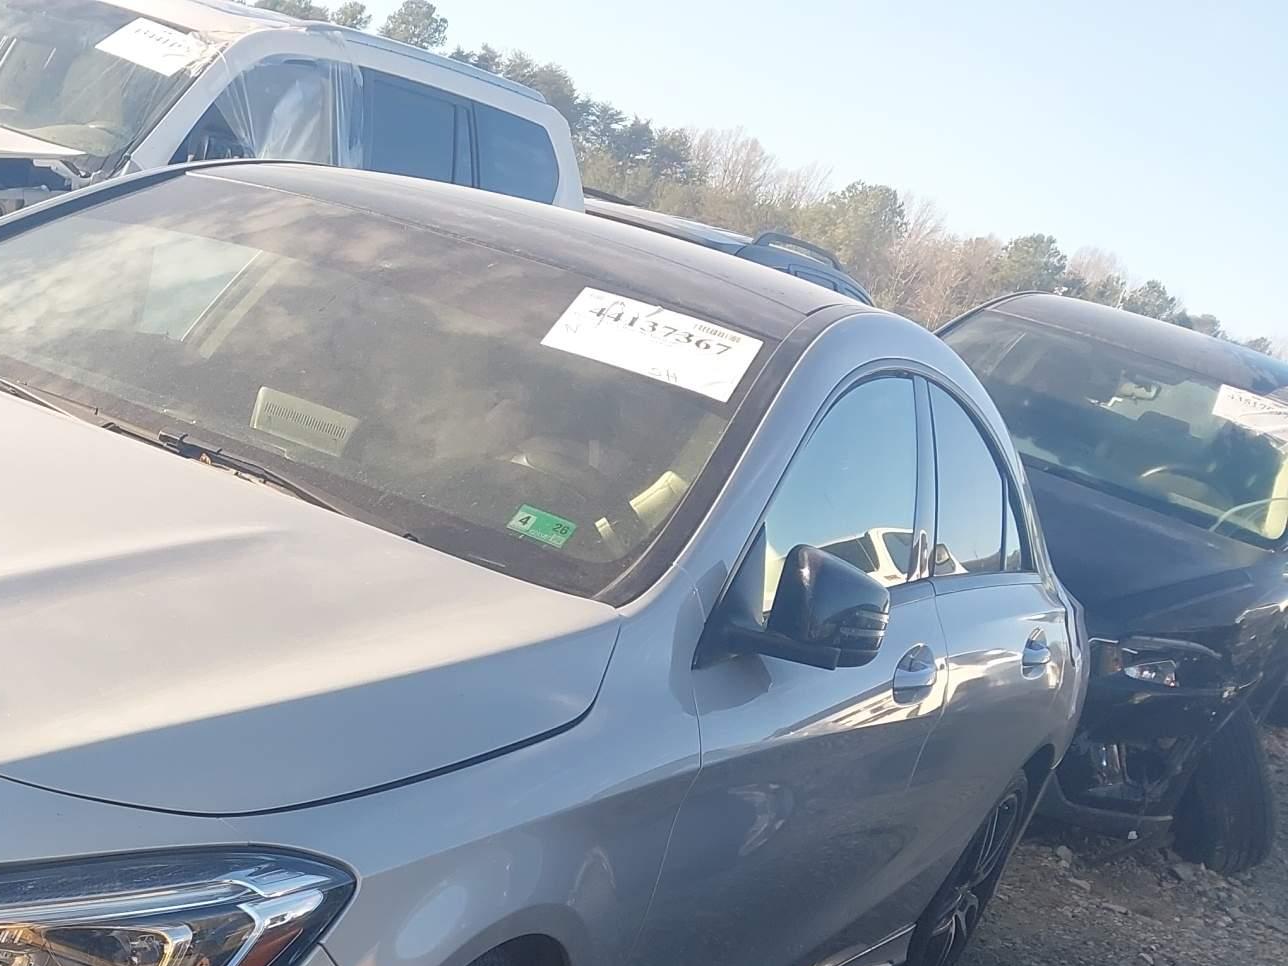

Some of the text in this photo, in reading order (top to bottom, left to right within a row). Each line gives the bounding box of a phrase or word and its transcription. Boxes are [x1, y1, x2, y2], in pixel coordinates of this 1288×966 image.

[588, 307, 732, 355] 44137367
[518, 515, 570, 535] 4 26
